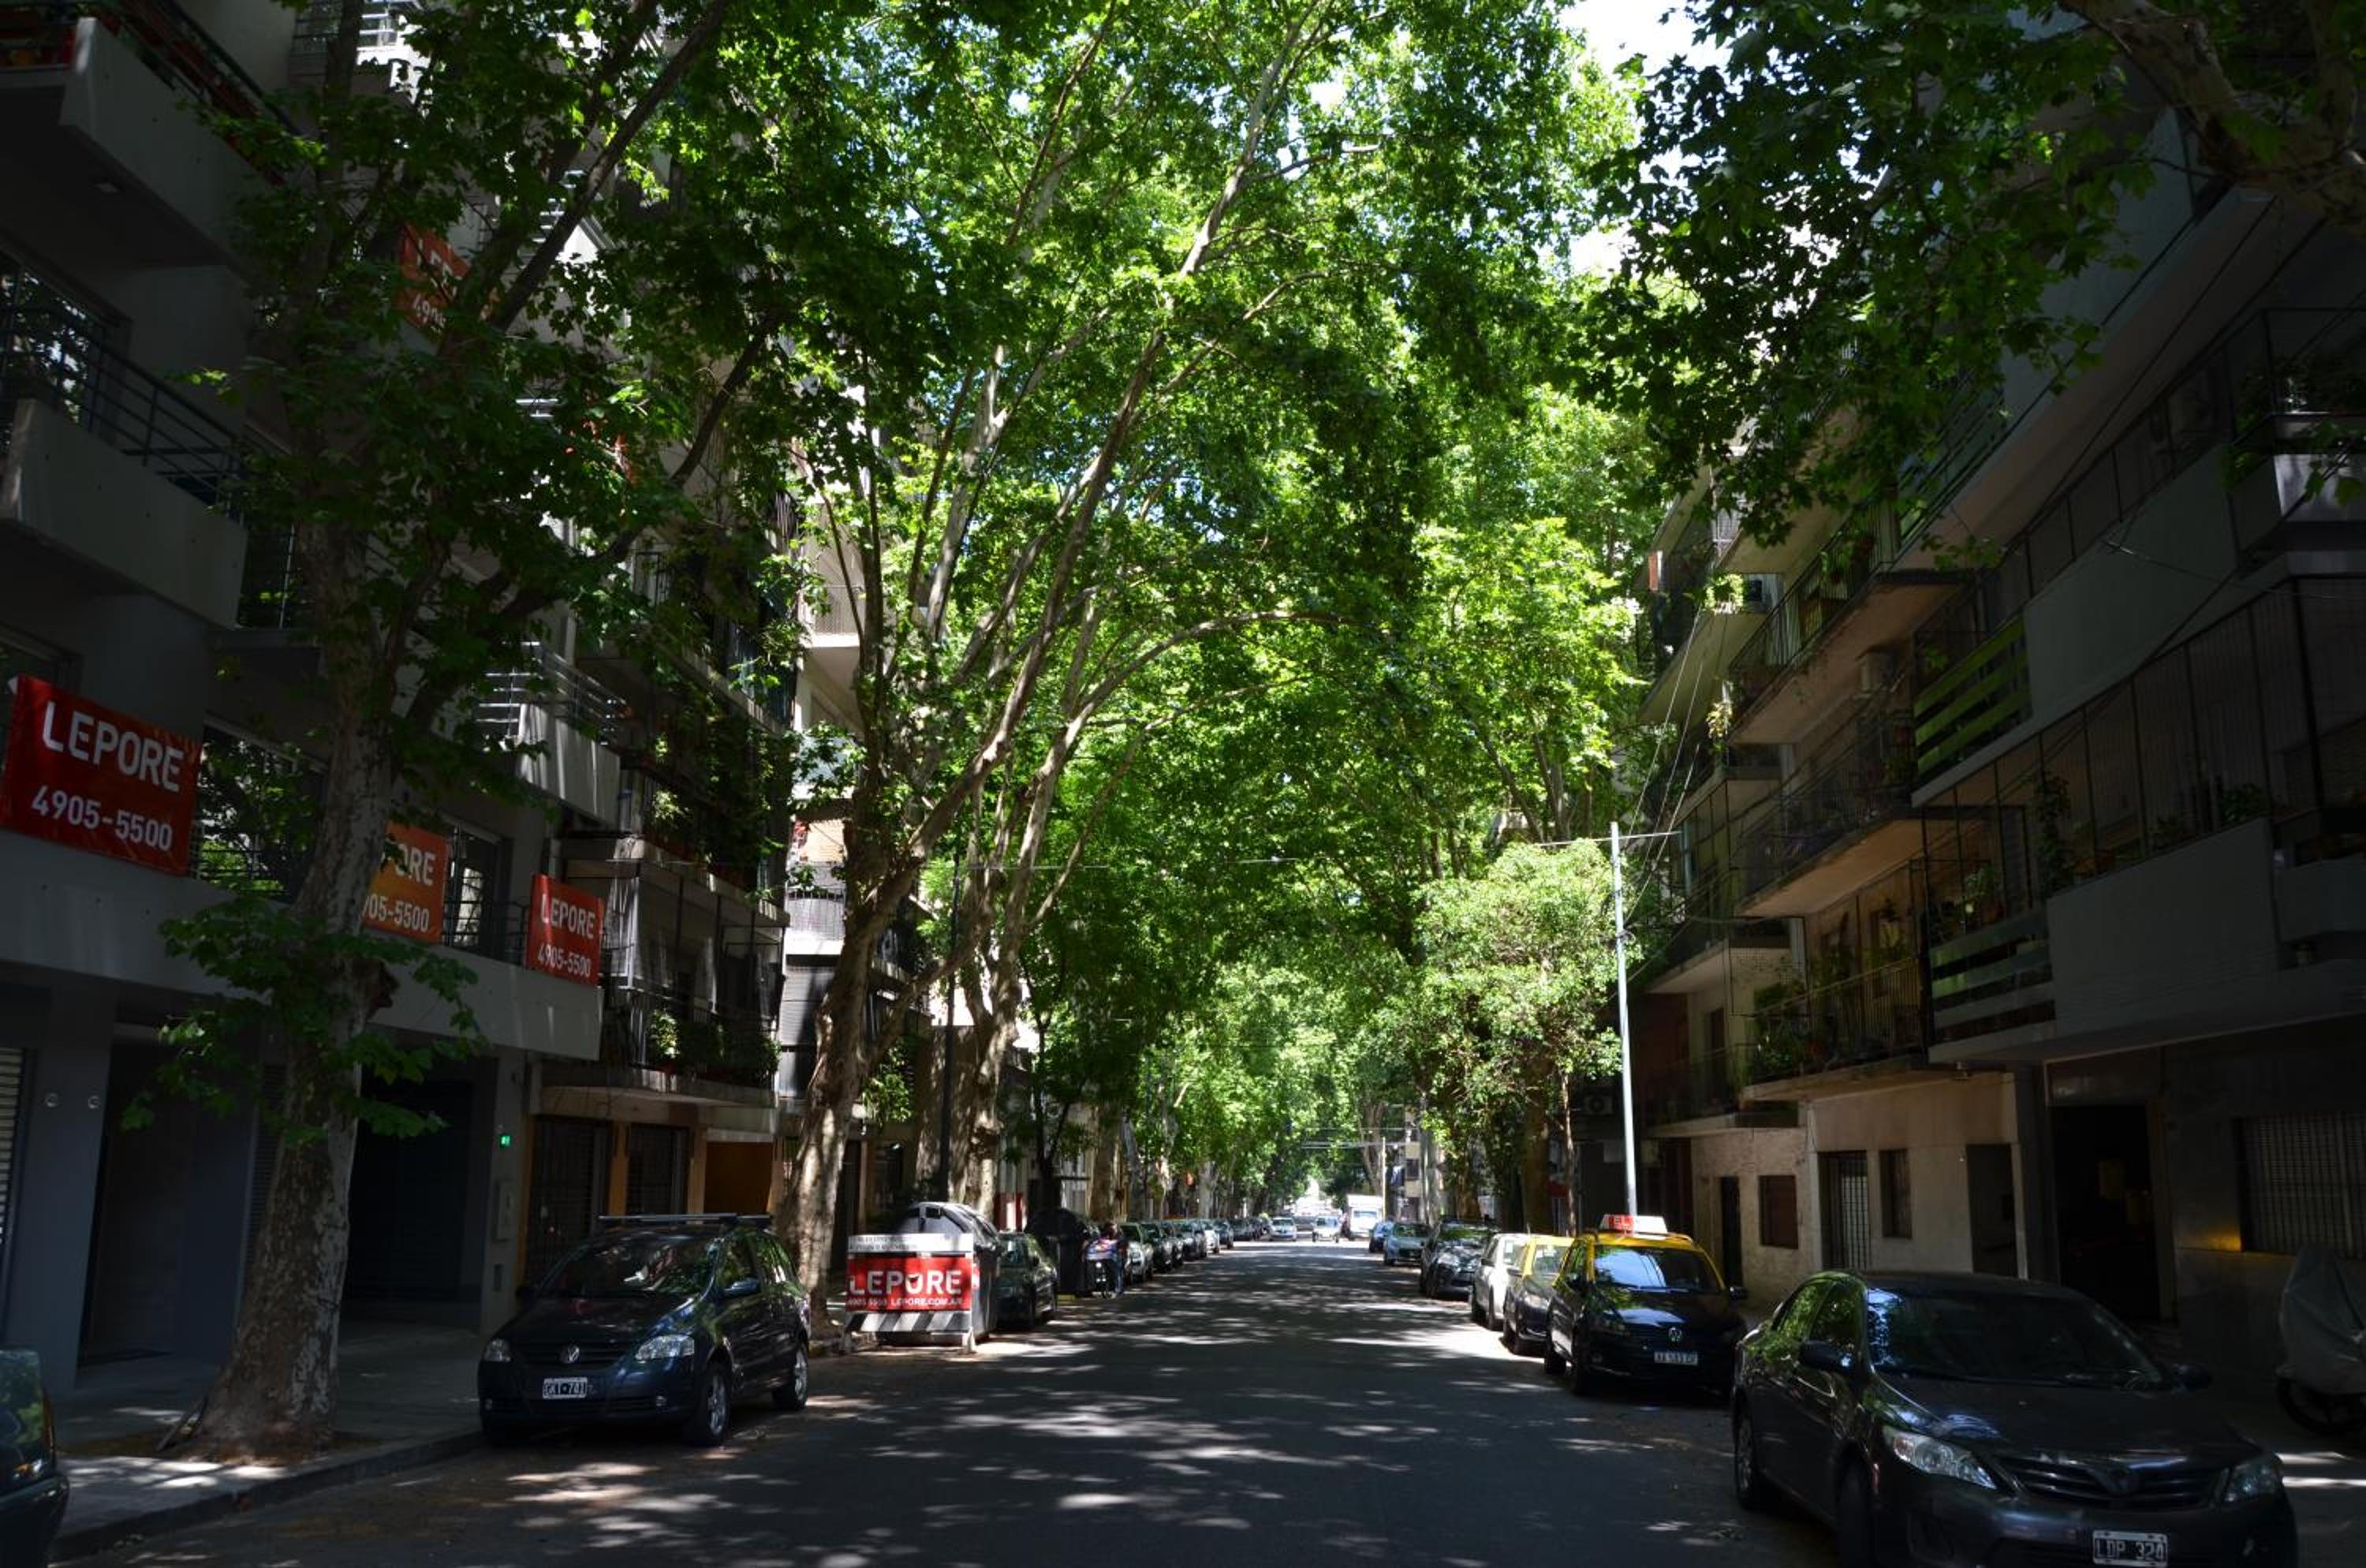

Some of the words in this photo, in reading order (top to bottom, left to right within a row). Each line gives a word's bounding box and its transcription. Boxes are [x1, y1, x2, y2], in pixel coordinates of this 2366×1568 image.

[42, 700, 185, 793] LEPORE
[31, 784, 173, 853] 4905-5500
[539, 893, 596, 939] LEPORE
[536, 943, 592, 978] 4905-5500
[848, 1269, 963, 1295] LEPORE
